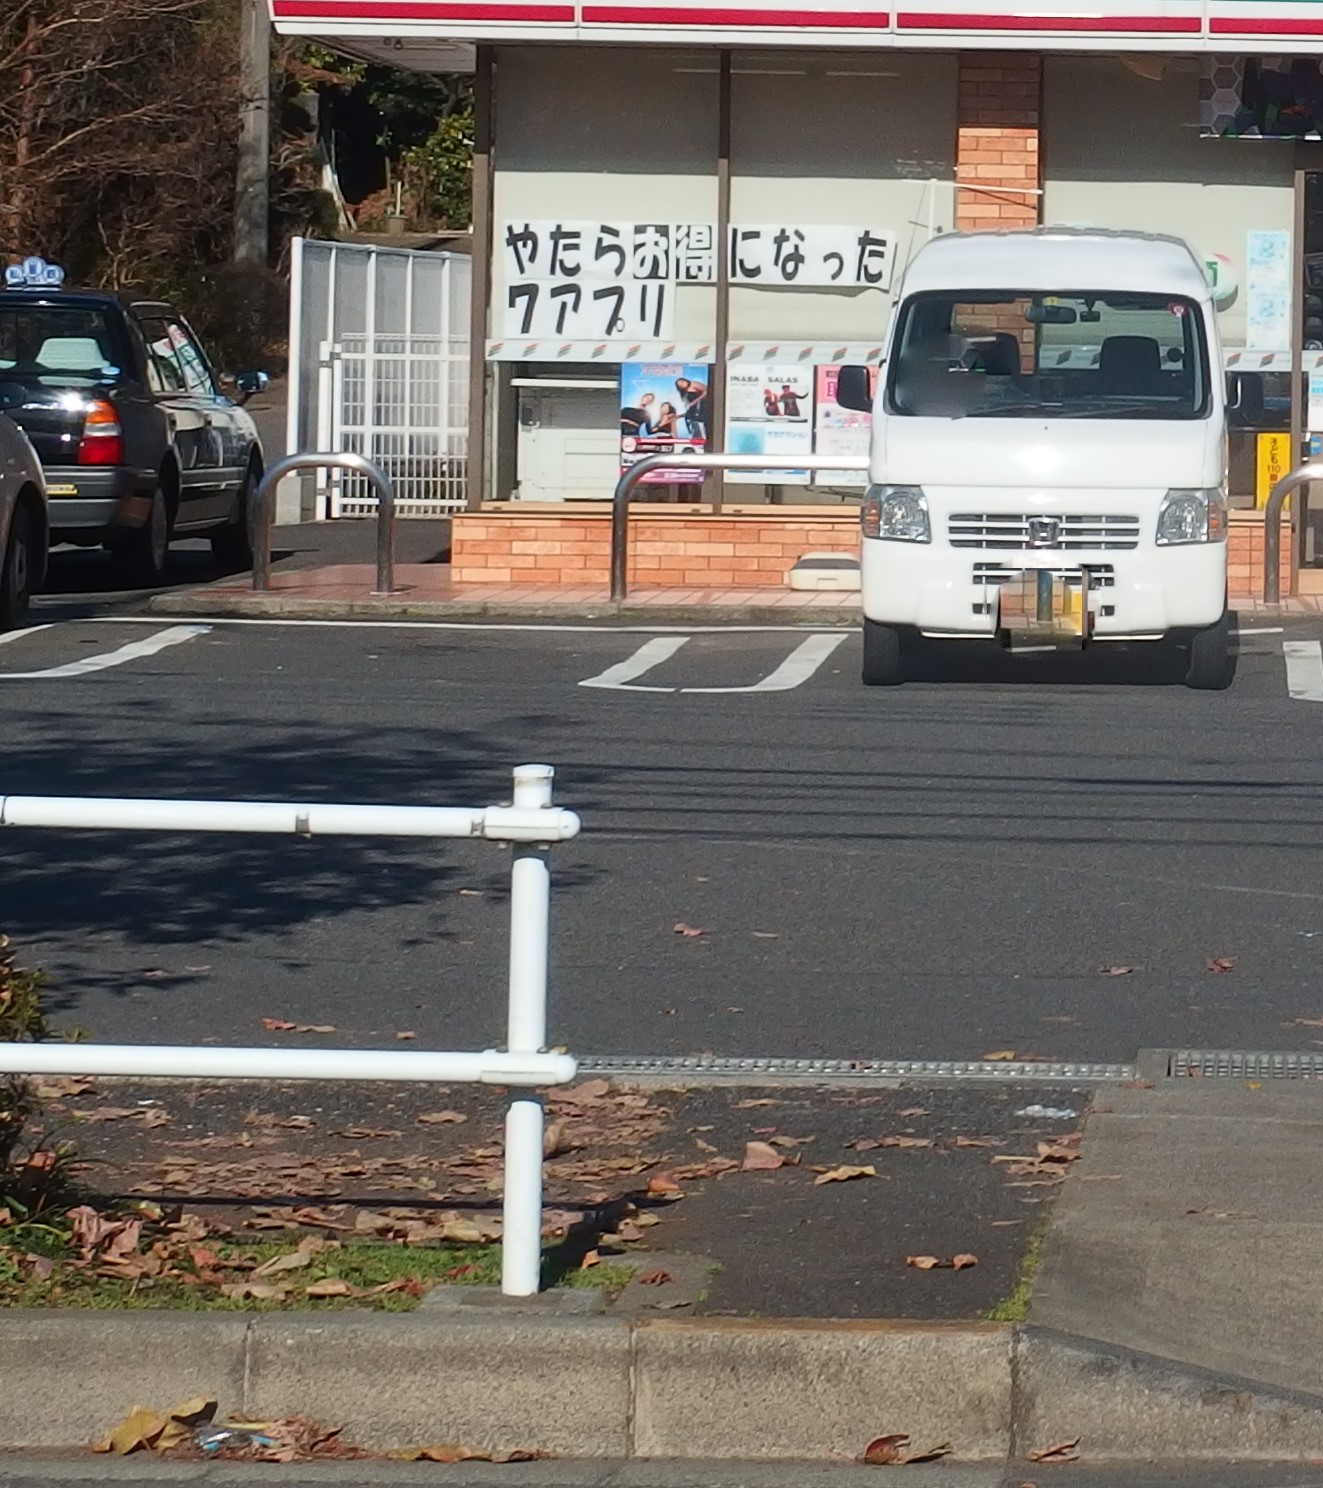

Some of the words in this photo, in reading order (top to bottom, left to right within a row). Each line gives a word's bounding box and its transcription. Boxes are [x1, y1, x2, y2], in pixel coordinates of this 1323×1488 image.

[506, 223, 888, 283] やたらお得になった
